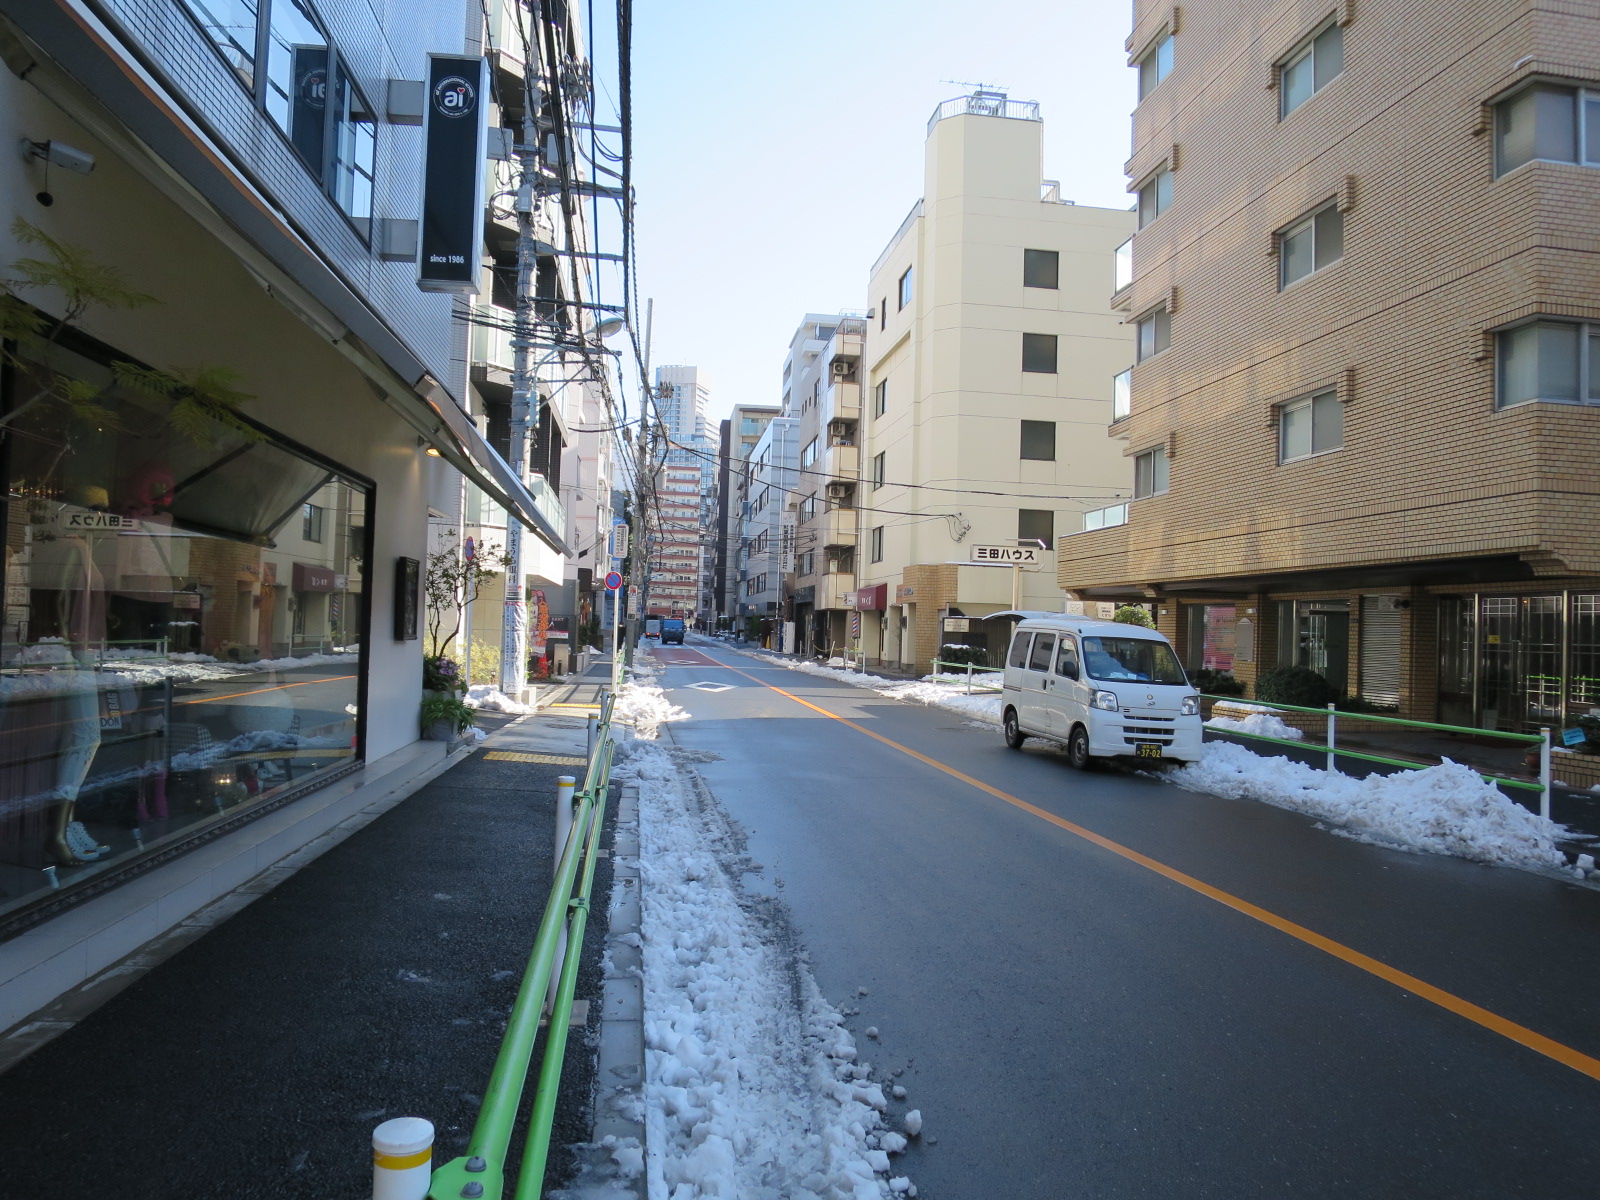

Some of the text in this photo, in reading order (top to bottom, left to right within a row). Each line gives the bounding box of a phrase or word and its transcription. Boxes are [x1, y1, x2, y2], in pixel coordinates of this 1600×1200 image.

[444, 87, 465, 107] ai
[430, 254, 465, 263] since 1986
[977, 548, 1035, 560] 三田ハウス
